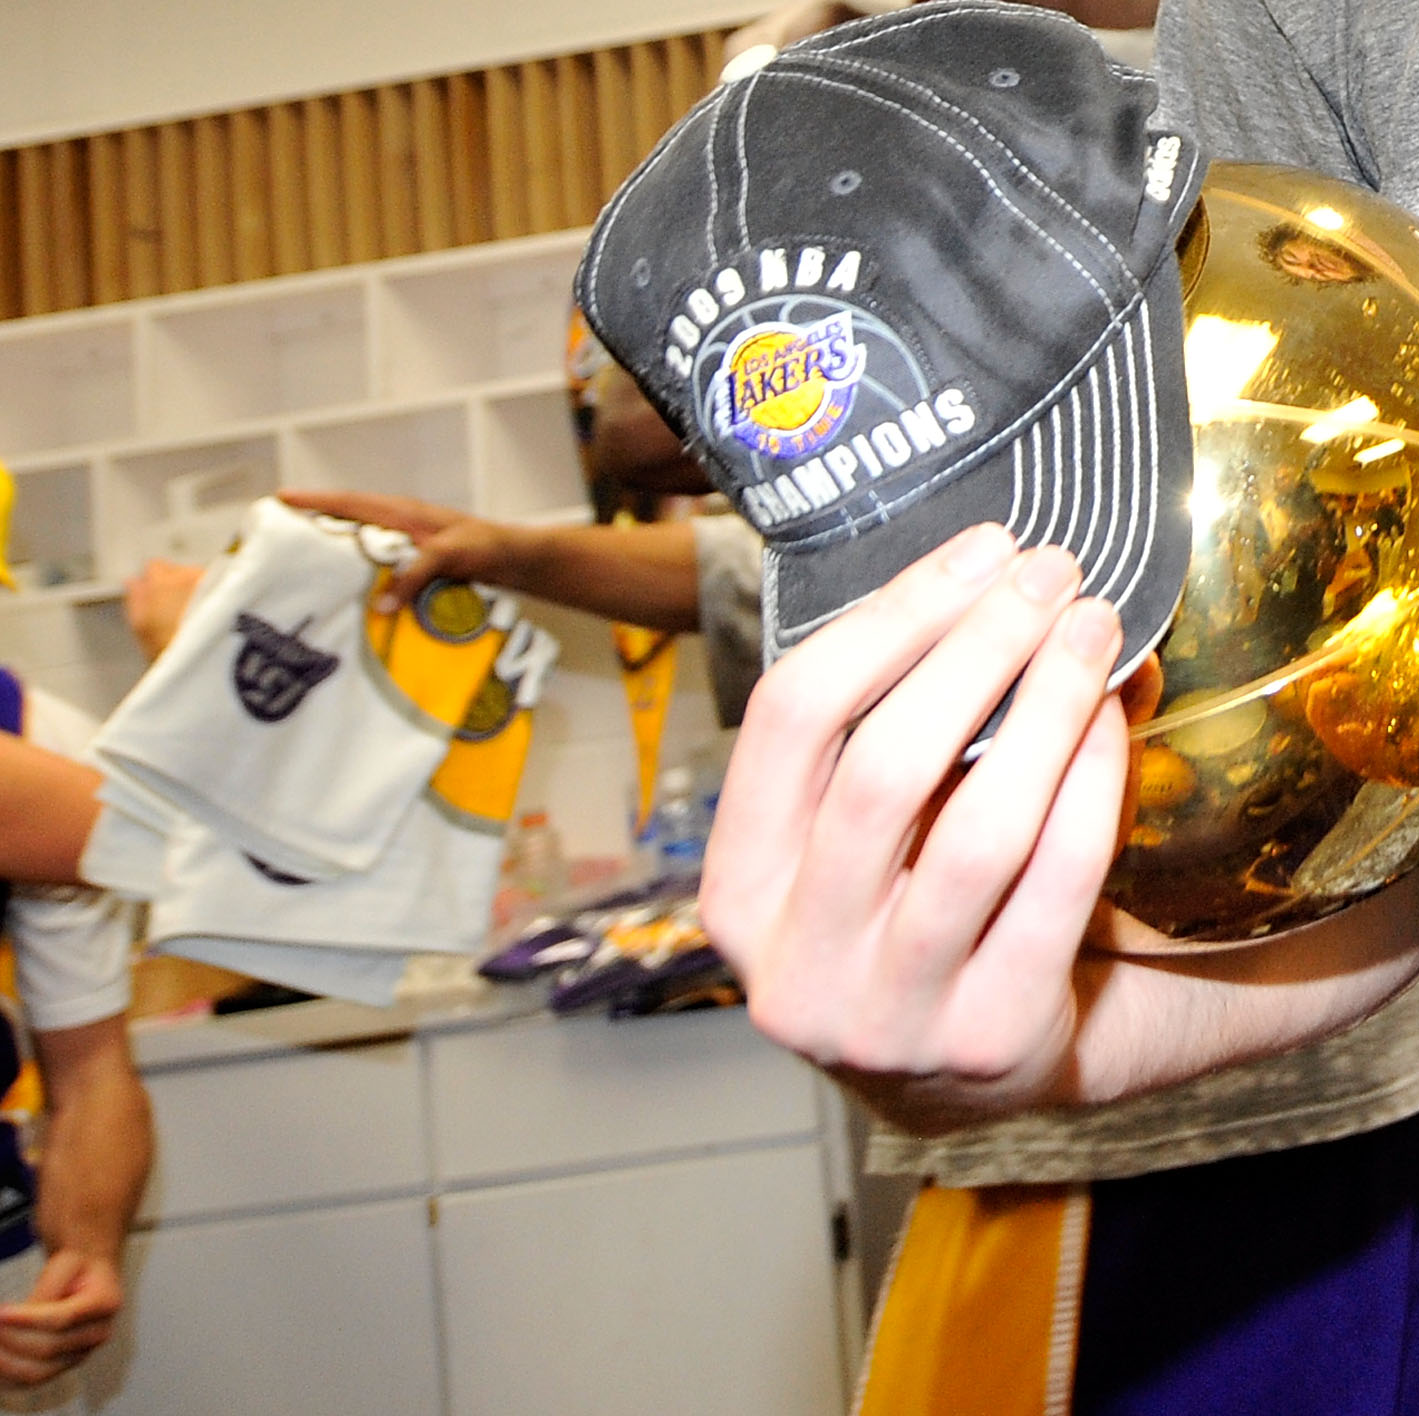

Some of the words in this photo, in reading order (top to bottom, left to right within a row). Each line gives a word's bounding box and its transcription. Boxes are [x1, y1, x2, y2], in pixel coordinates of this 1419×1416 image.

[665, 267, 746, 379] 2009
[758, 246, 862, 292] NBA
[743, 354, 770, 376] LOS
[726, 334, 858, 427] LAKERS
[741, 387, 977, 528] CHAMPIONS
